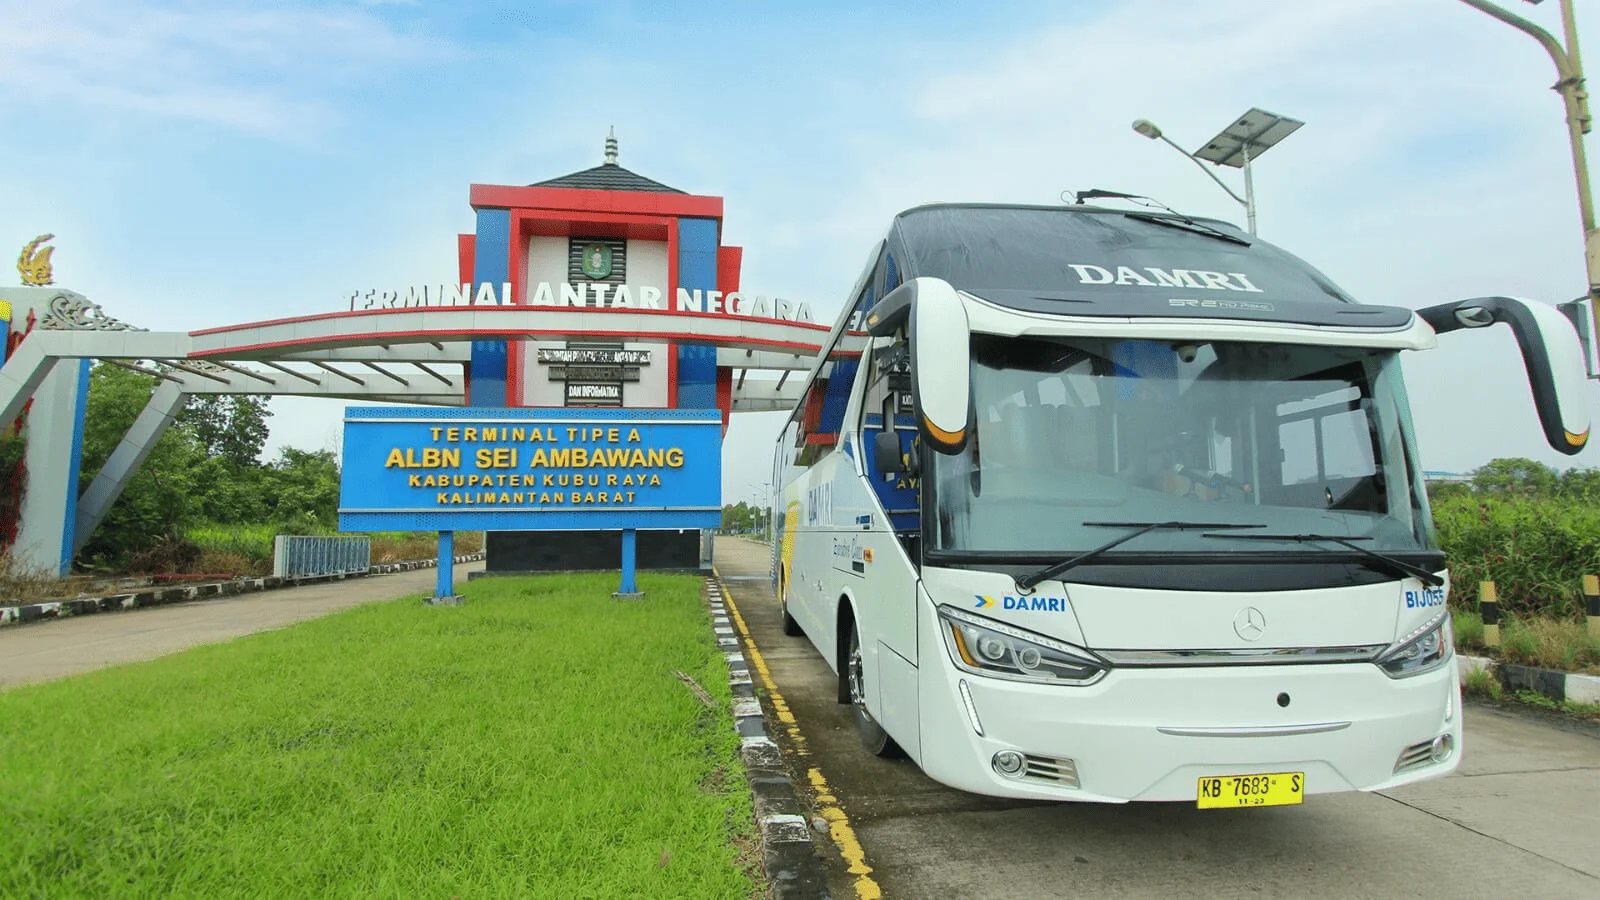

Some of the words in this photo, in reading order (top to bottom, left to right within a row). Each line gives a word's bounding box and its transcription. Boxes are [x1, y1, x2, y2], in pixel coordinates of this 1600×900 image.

[1067, 264, 1265, 293] DAMRI
[343, 281, 517, 311] TERMINAL
[532, 281, 662, 310] ANTAR
[676, 287, 815, 322] NEGARA
[430, 427, 558, 443] TERMINAL
[567, 427, 619, 442] TIPE
[628, 427, 642, 442] A
[384, 447, 461, 469] ALBN
[475, 448, 518, 469] SEI
[530, 447, 685, 468] AMBAWANG
[408, 474, 535, 488] KABUPATEN
[543, 474, 600, 487] KUBU
[607, 474, 662, 487] RAYA
[436, 491, 565, 504] KALIMANTAN
[571, 491, 636, 503] BARAT
[1003, 596, 1066, 612] DAMRI
[1202, 779, 1221, 798] KB
[1233, 776, 1269, 797] 7683
[1291, 774, 1301, 793] S
